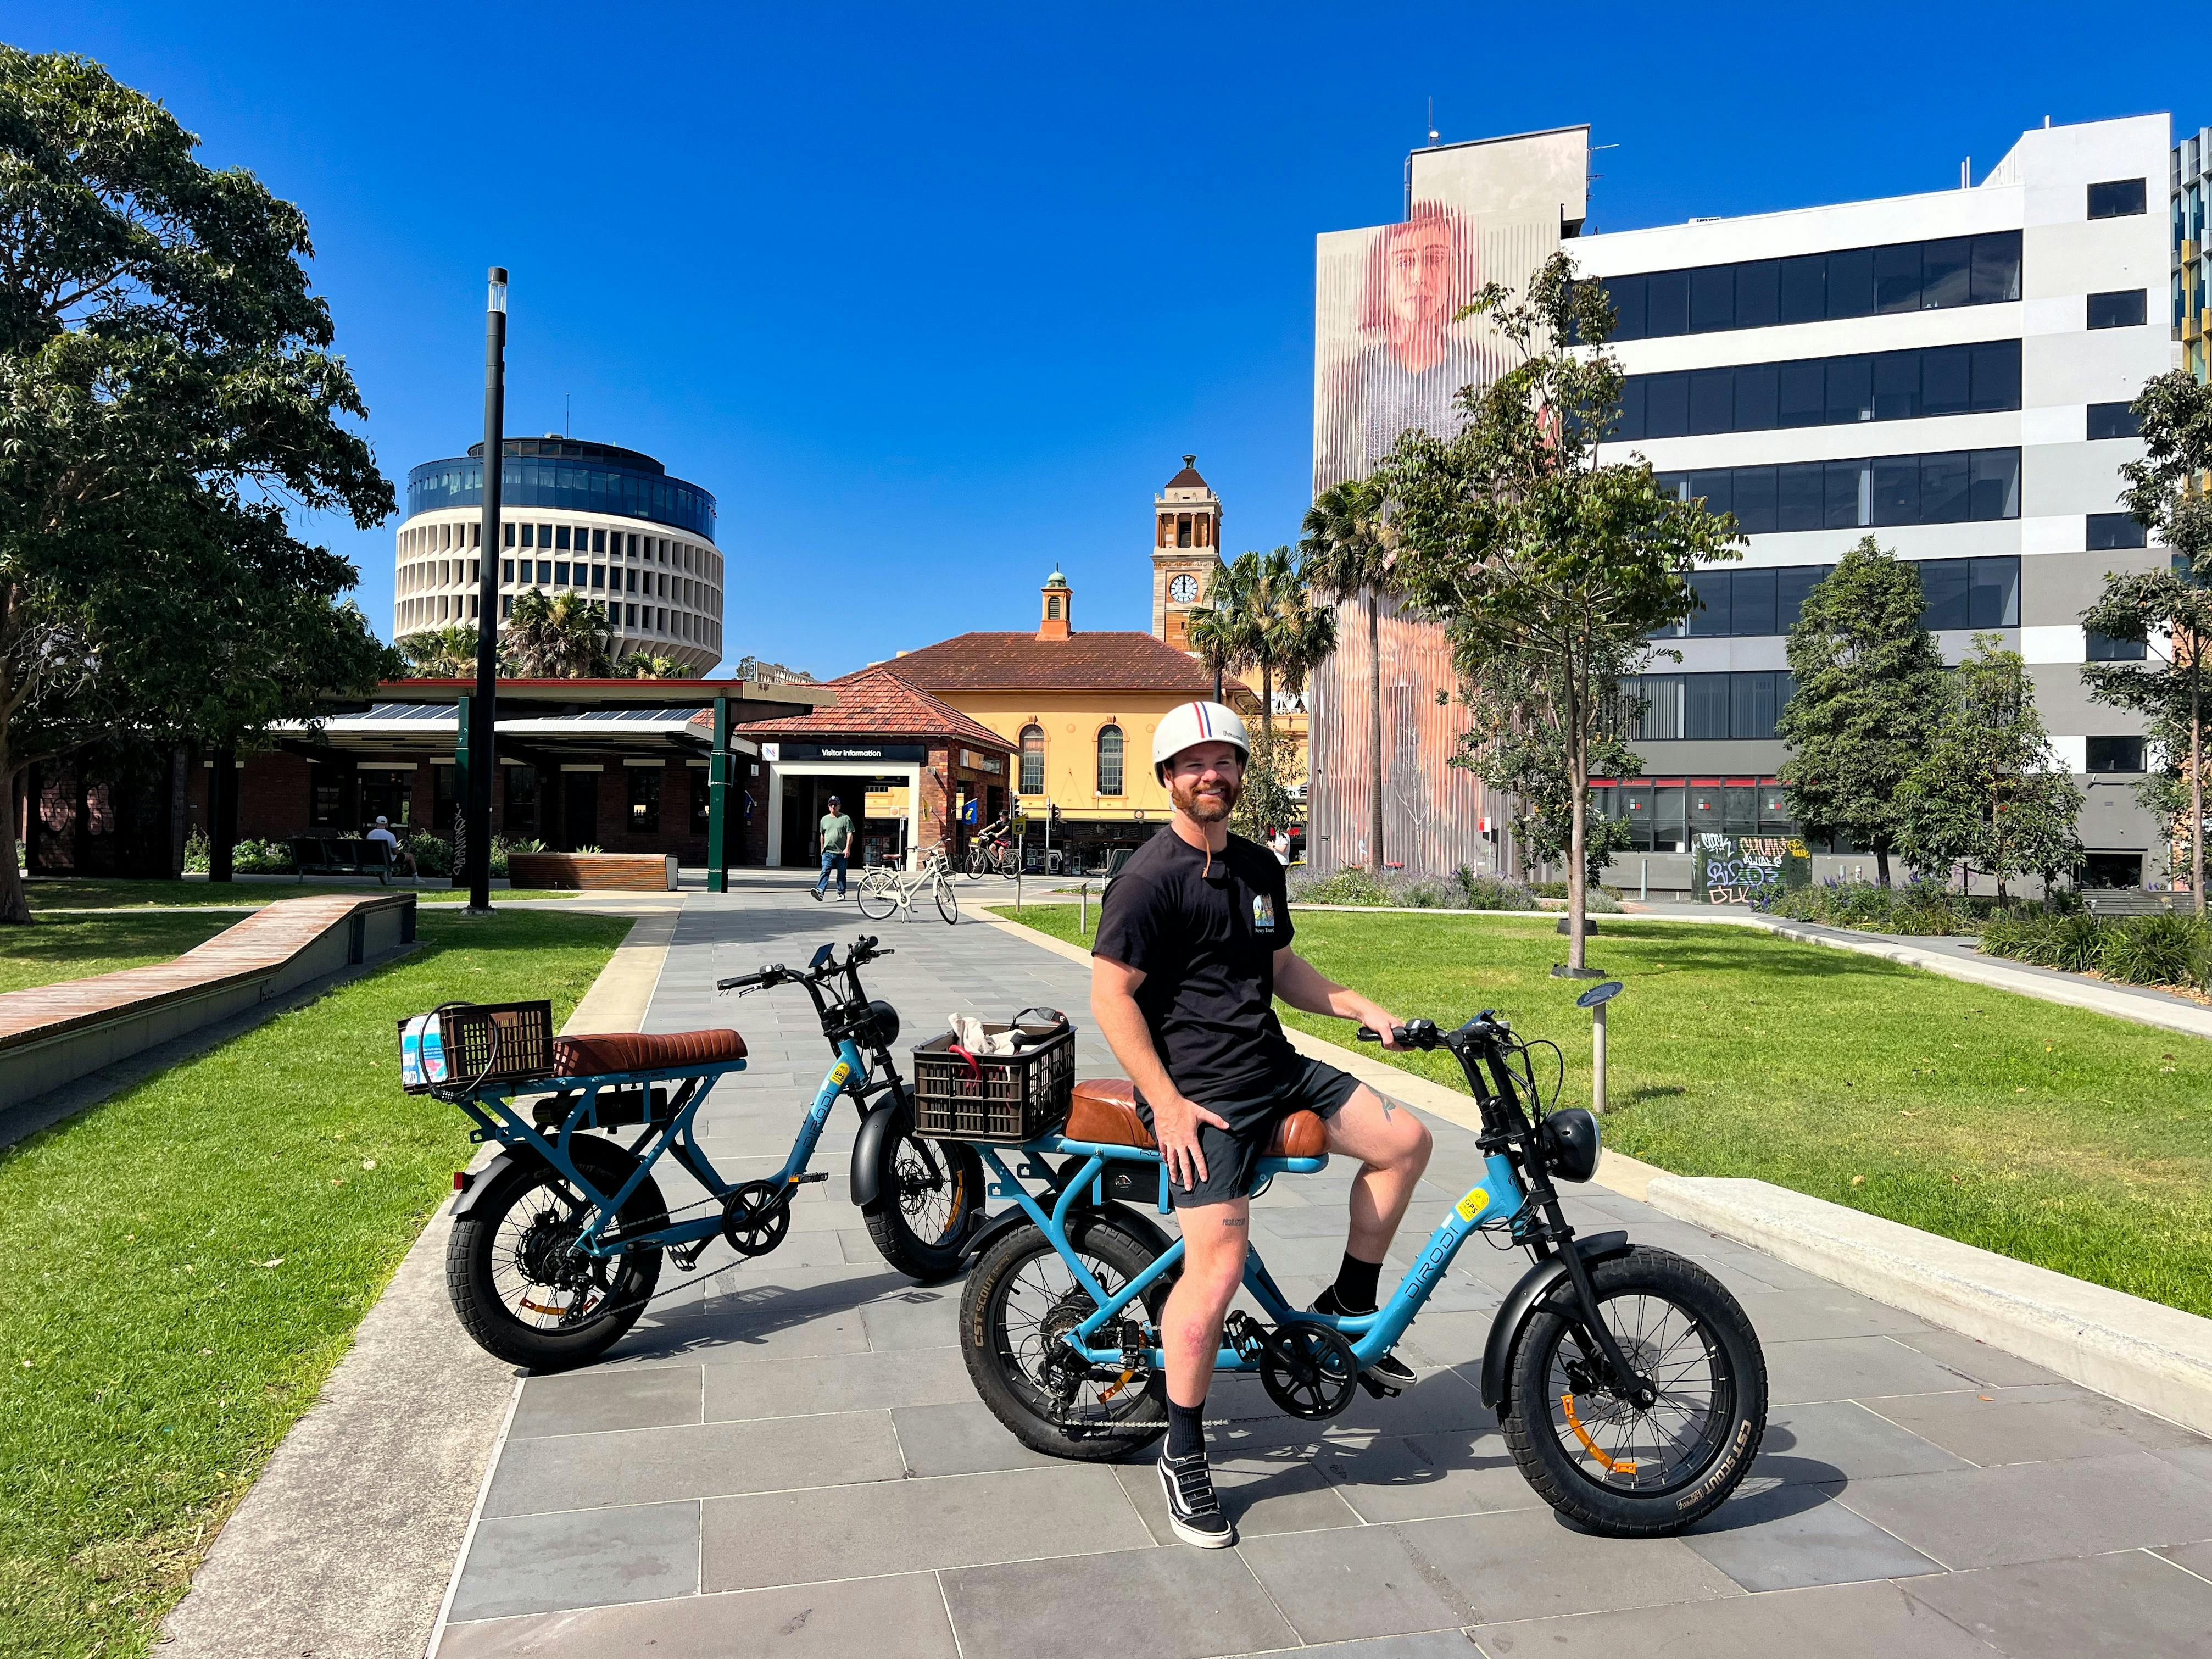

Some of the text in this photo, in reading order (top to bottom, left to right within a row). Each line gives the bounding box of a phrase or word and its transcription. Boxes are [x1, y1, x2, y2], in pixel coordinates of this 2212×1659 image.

[835, 1071, 845, 1079] GPS
[803, 1091, 834, 1149] DIRODI
[1465, 1199, 1478, 1214] GPS
[1405, 1226, 1459, 1300] DIRODI
[973, 1274, 995, 1347] CST SCOUT
[1704, 1419, 1752, 1495] CST SCOUT
